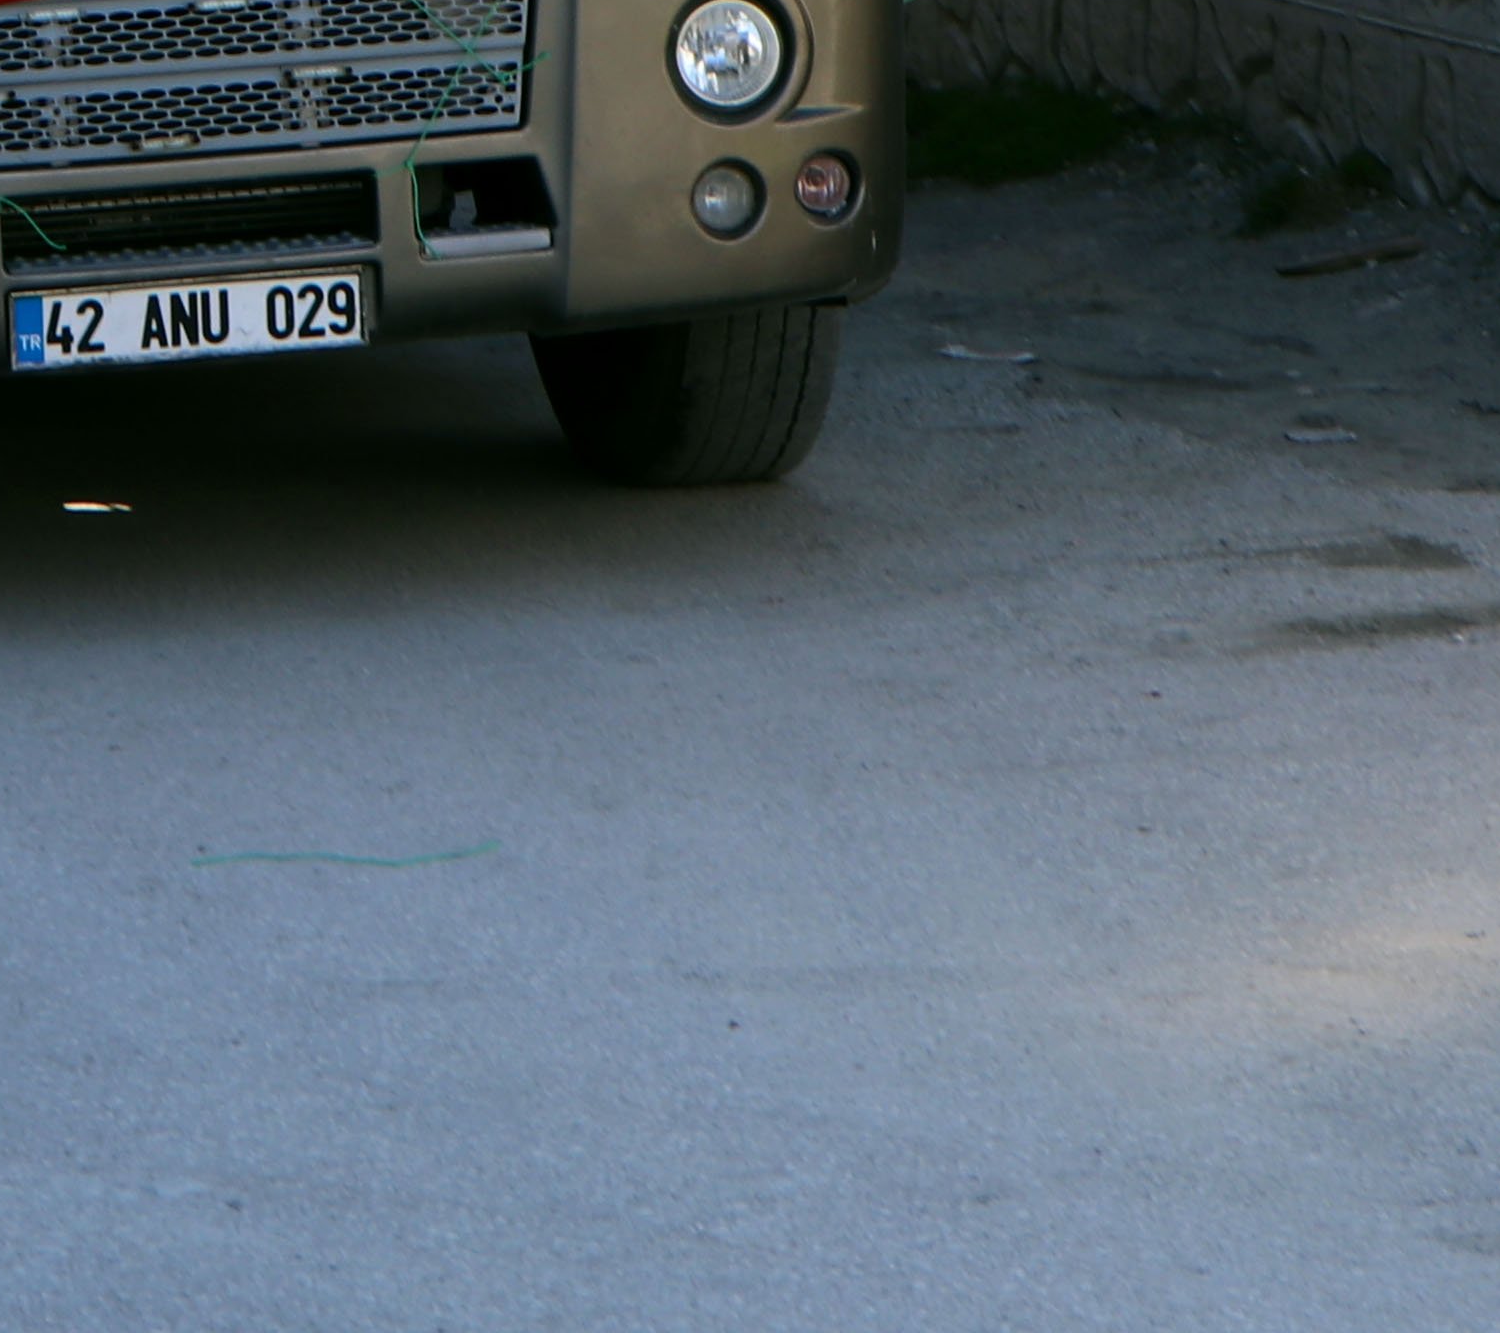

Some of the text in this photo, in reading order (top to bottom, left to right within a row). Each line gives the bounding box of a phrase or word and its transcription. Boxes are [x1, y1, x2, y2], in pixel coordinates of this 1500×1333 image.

[19, 282, 356, 355] TR 42 ANU 029
